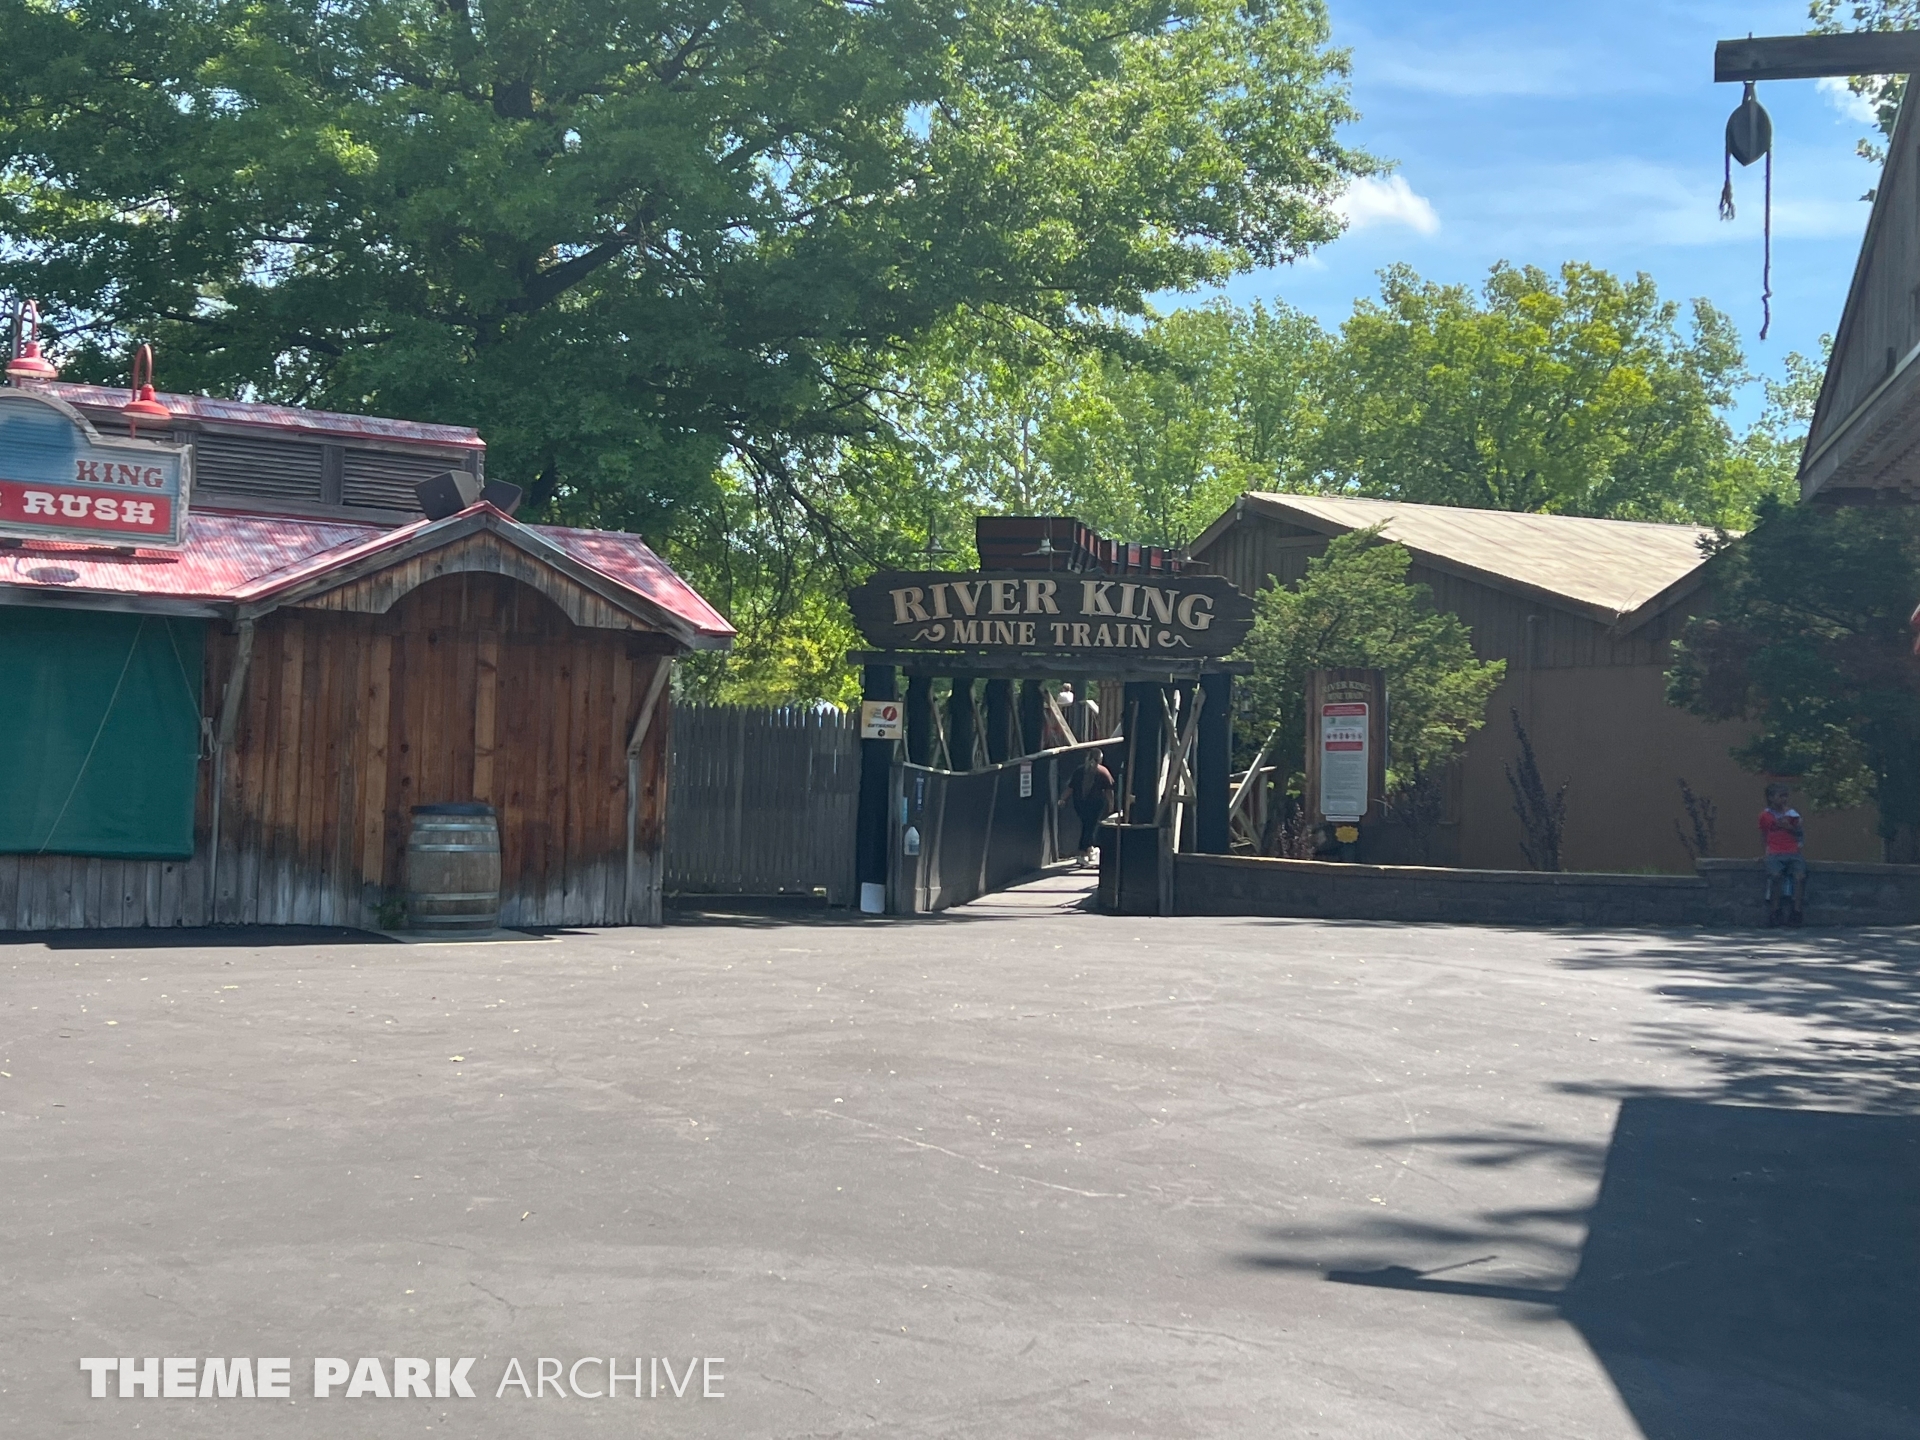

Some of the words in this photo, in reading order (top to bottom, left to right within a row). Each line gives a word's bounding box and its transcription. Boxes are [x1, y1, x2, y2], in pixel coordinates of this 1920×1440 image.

[76, 460, 164, 488] KING
[23, 491, 155, 524] RUSH
[889, 579, 1060, 625] RIVER
[1080, 580, 1215, 630] KING
[952, 620, 1036, 645] MINE
[1050, 622, 1152, 648] TRAIN
